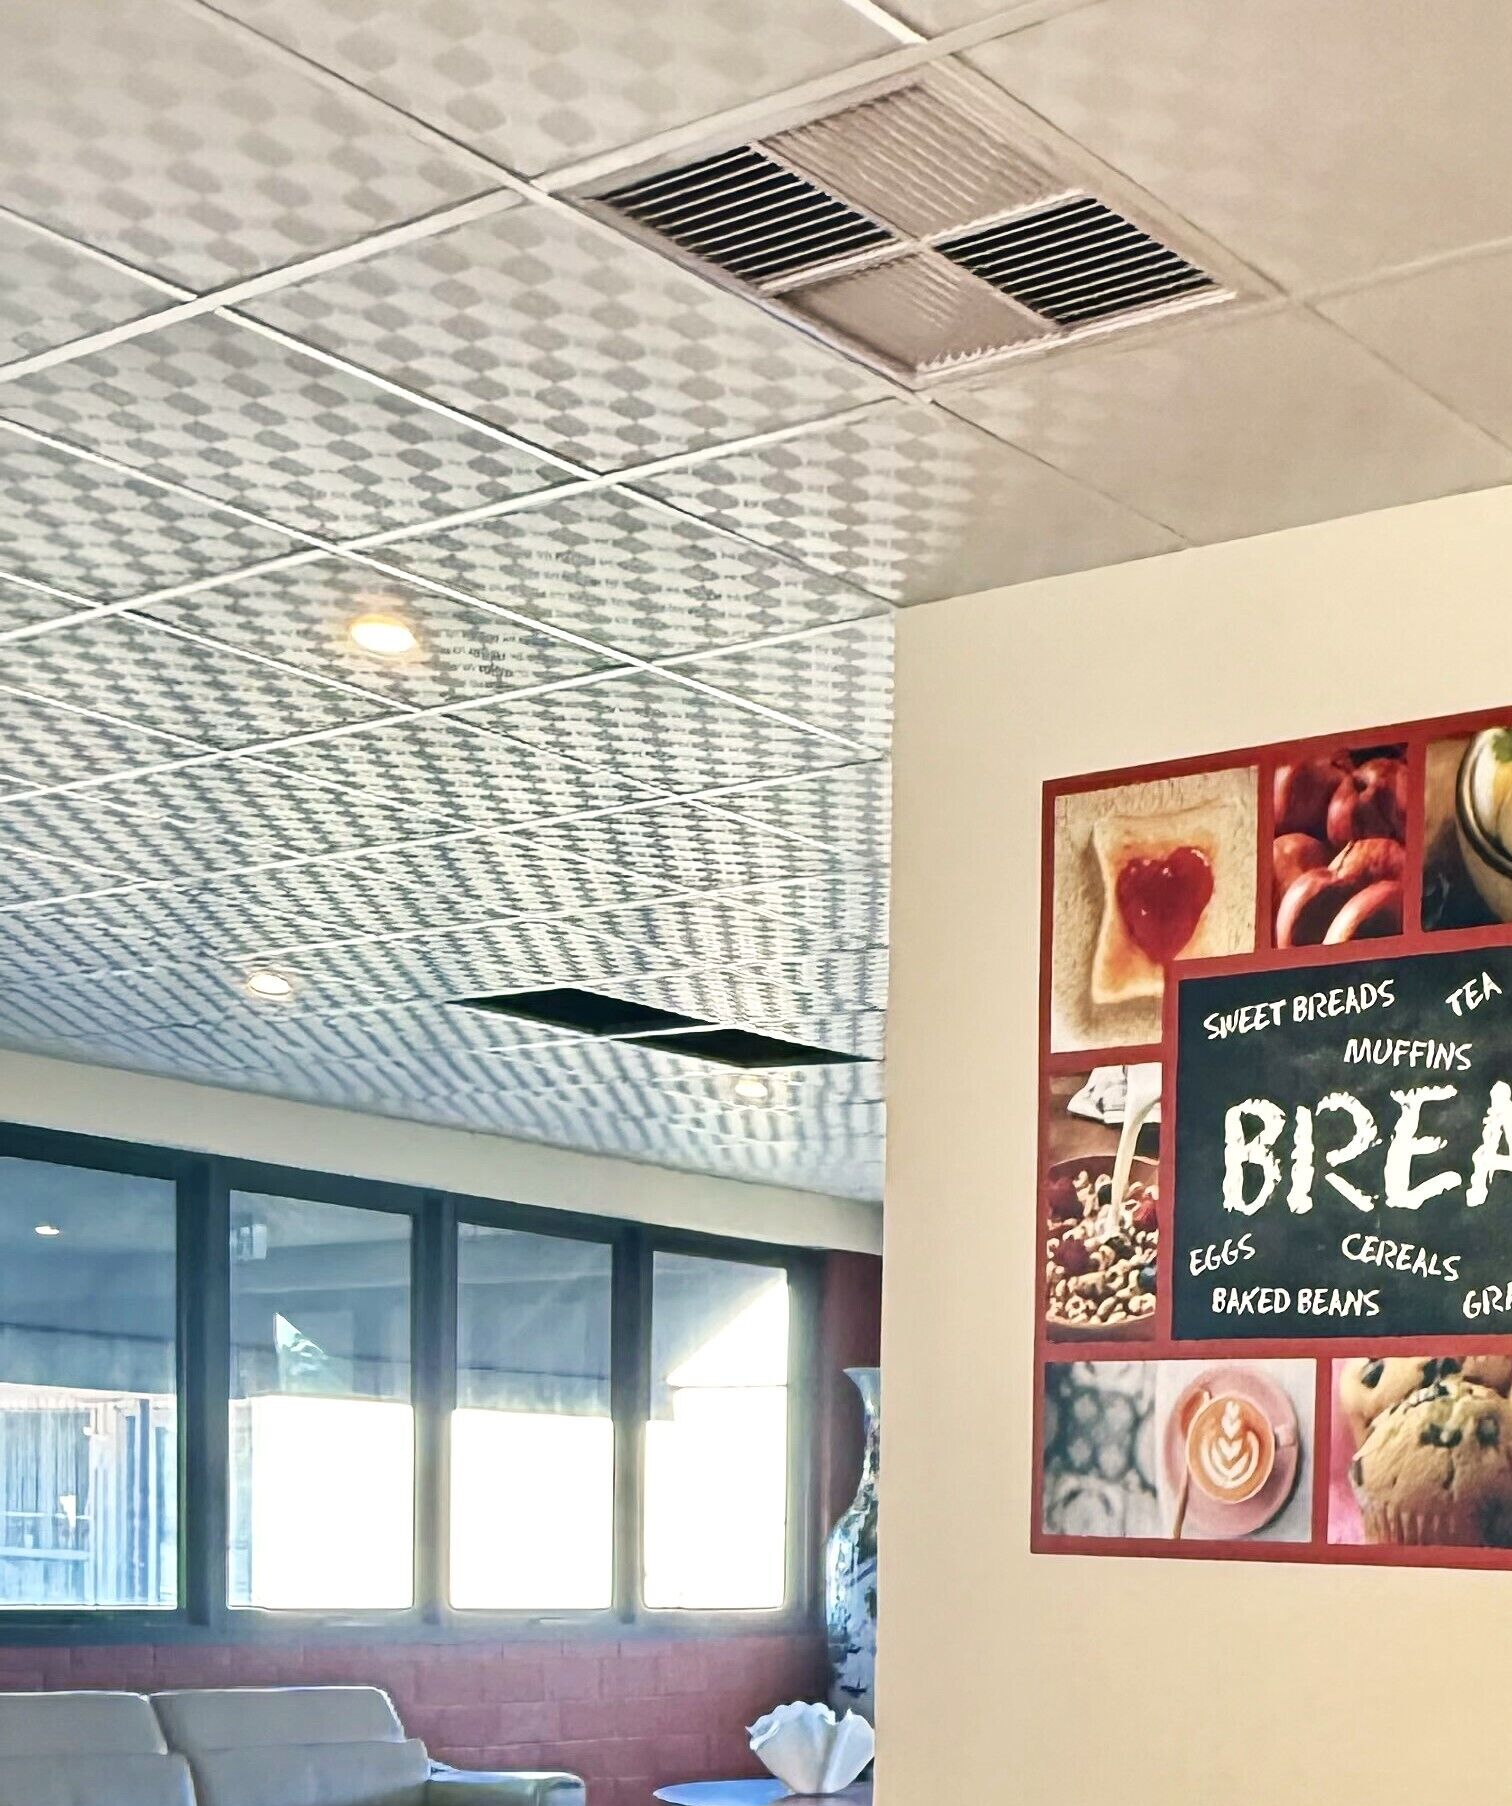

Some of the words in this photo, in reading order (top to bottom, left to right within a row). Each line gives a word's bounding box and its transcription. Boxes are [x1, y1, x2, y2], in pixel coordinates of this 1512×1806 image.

[1203, 998, 1287, 1040] SWEET
[1292, 978, 1395, 1023] BREADS
[1444, 971, 1503, 1017] TEA
[1343, 1037, 1473, 1071] MUFFINS
[1189, 1232, 1256, 1277] EGGS
[1341, 1233, 1462, 1282] CEREALS
[1211, 1286, 1292, 1316] BAKED
[1297, 1288, 1380, 1318] BEANS
